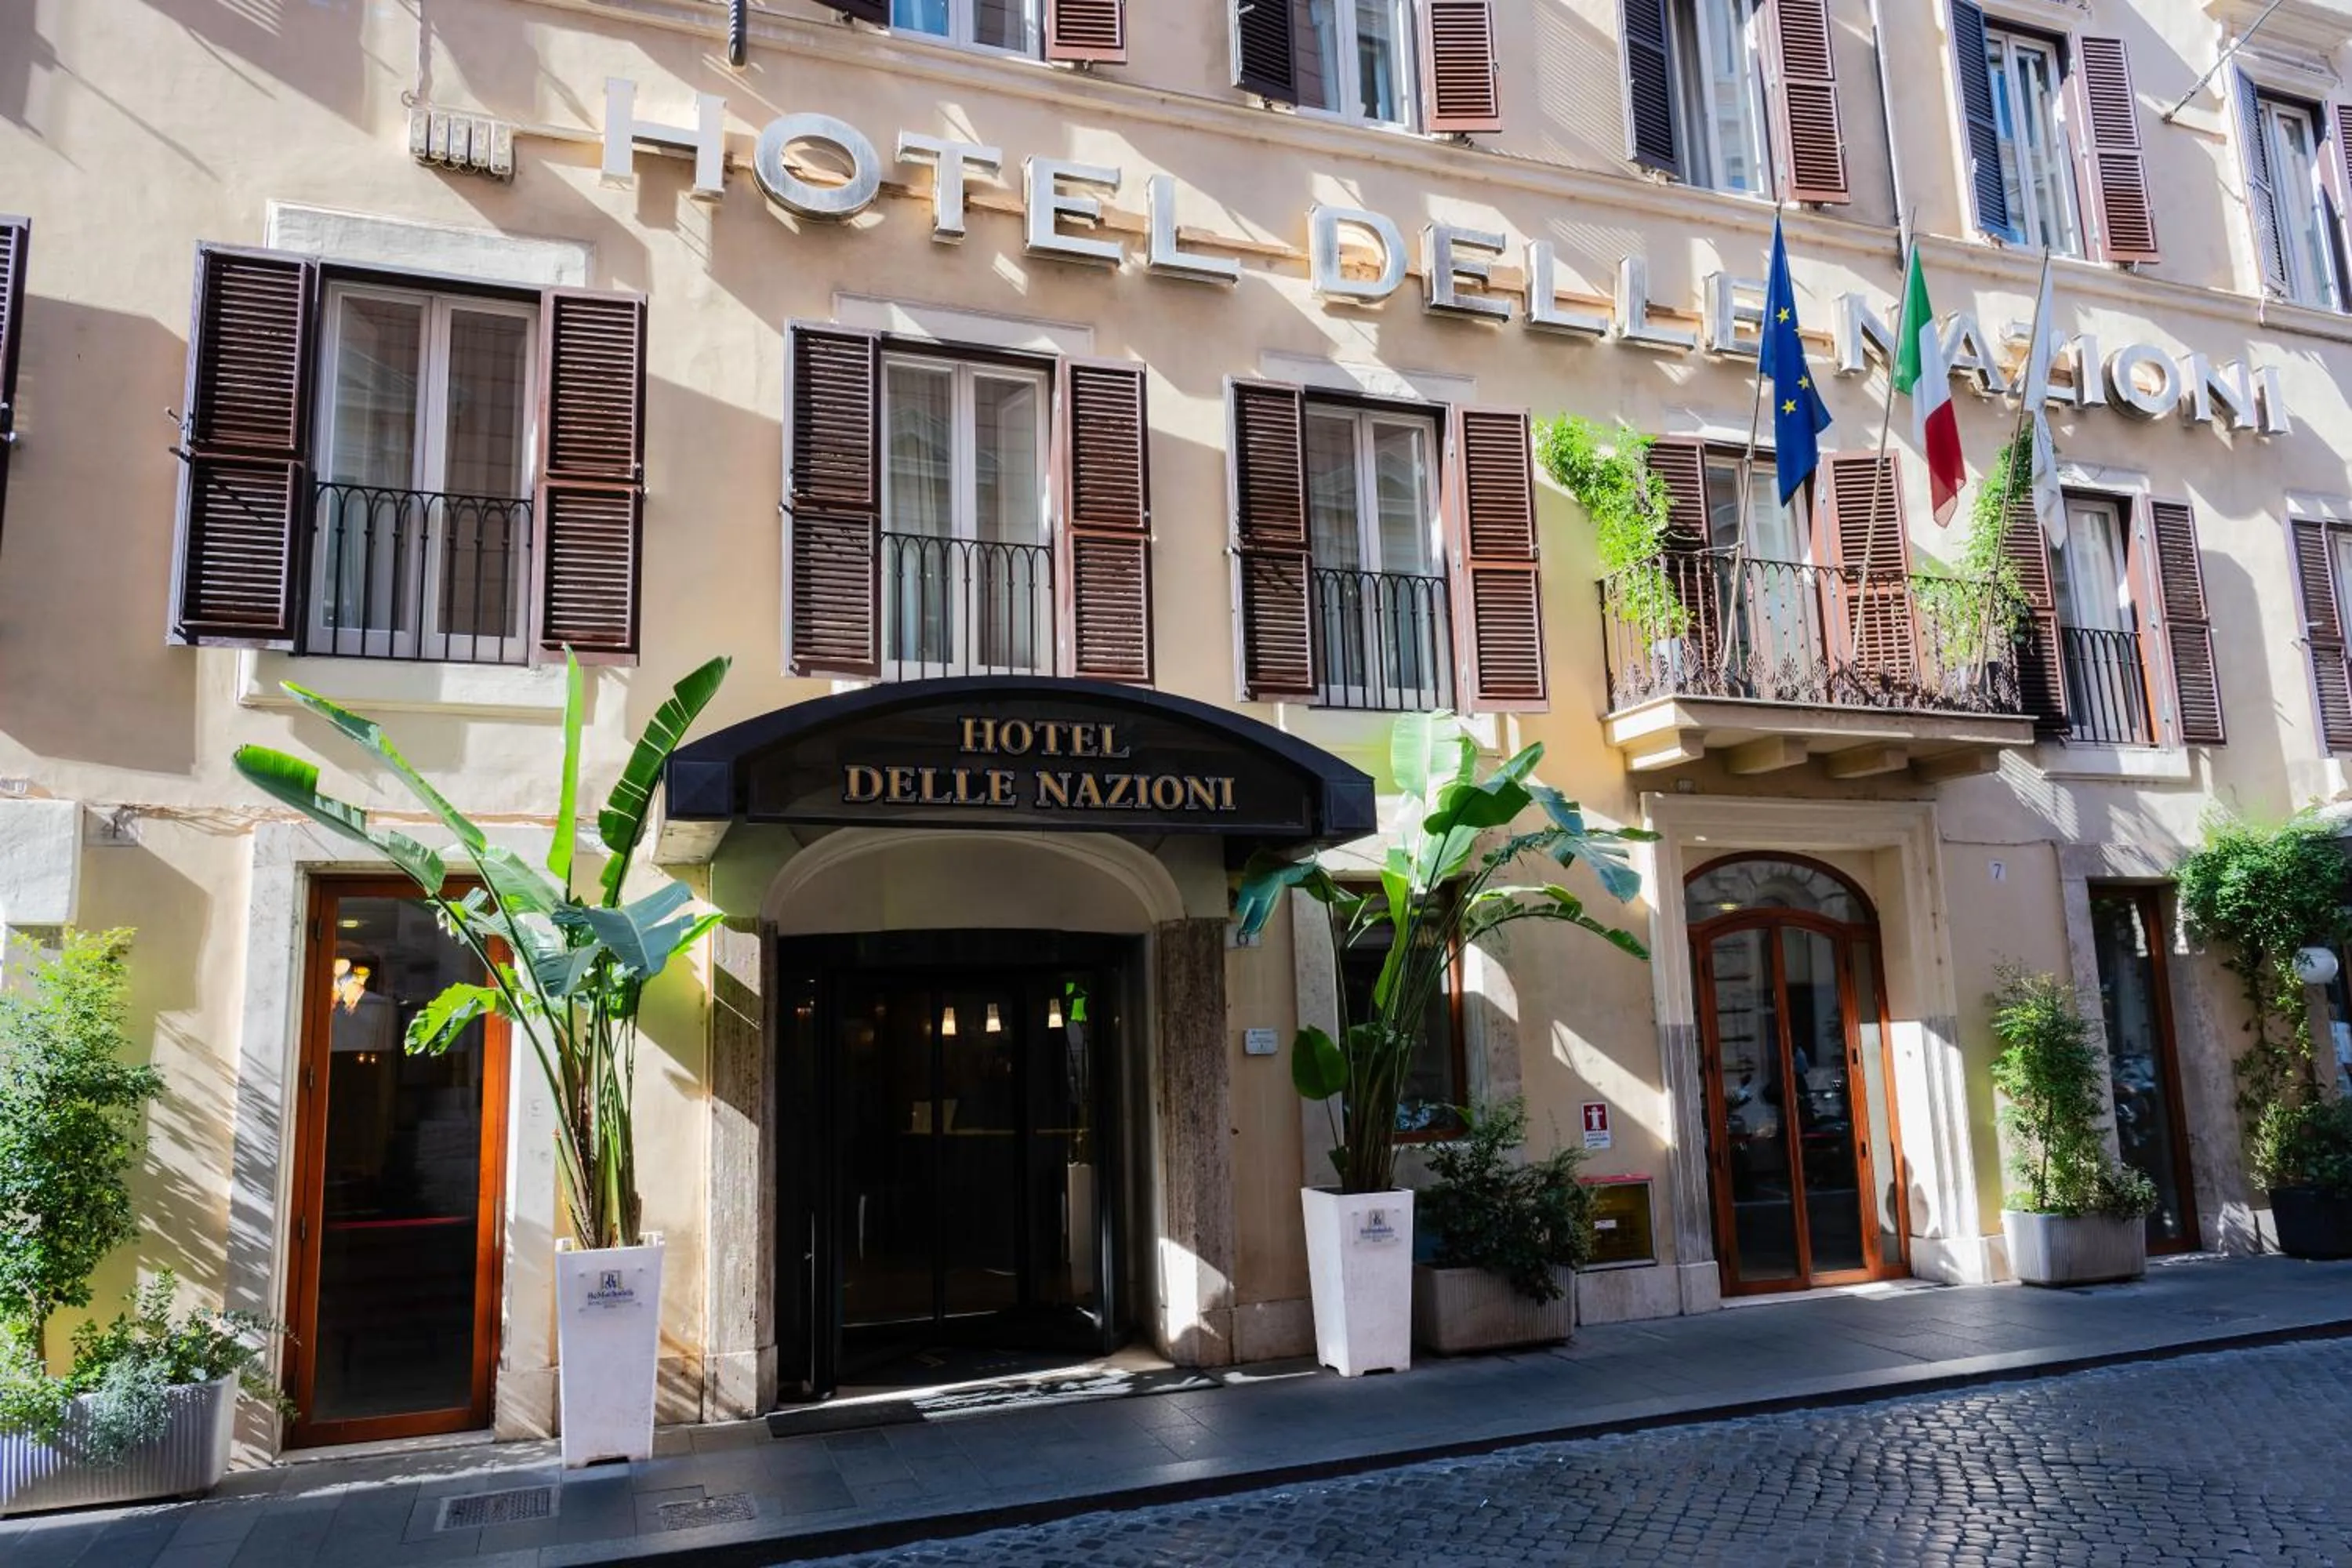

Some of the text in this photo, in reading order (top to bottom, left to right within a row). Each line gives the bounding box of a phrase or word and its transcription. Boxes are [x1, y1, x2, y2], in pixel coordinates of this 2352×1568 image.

[601, 77, 1241, 287] HOTEL
[1306, 203, 1767, 358] DELLE
[959, 717, 1131, 759] HOTEL
[842, 764, 1237, 811] DELLE NAZIONI
[1993, 862, 2002, 879] 7
